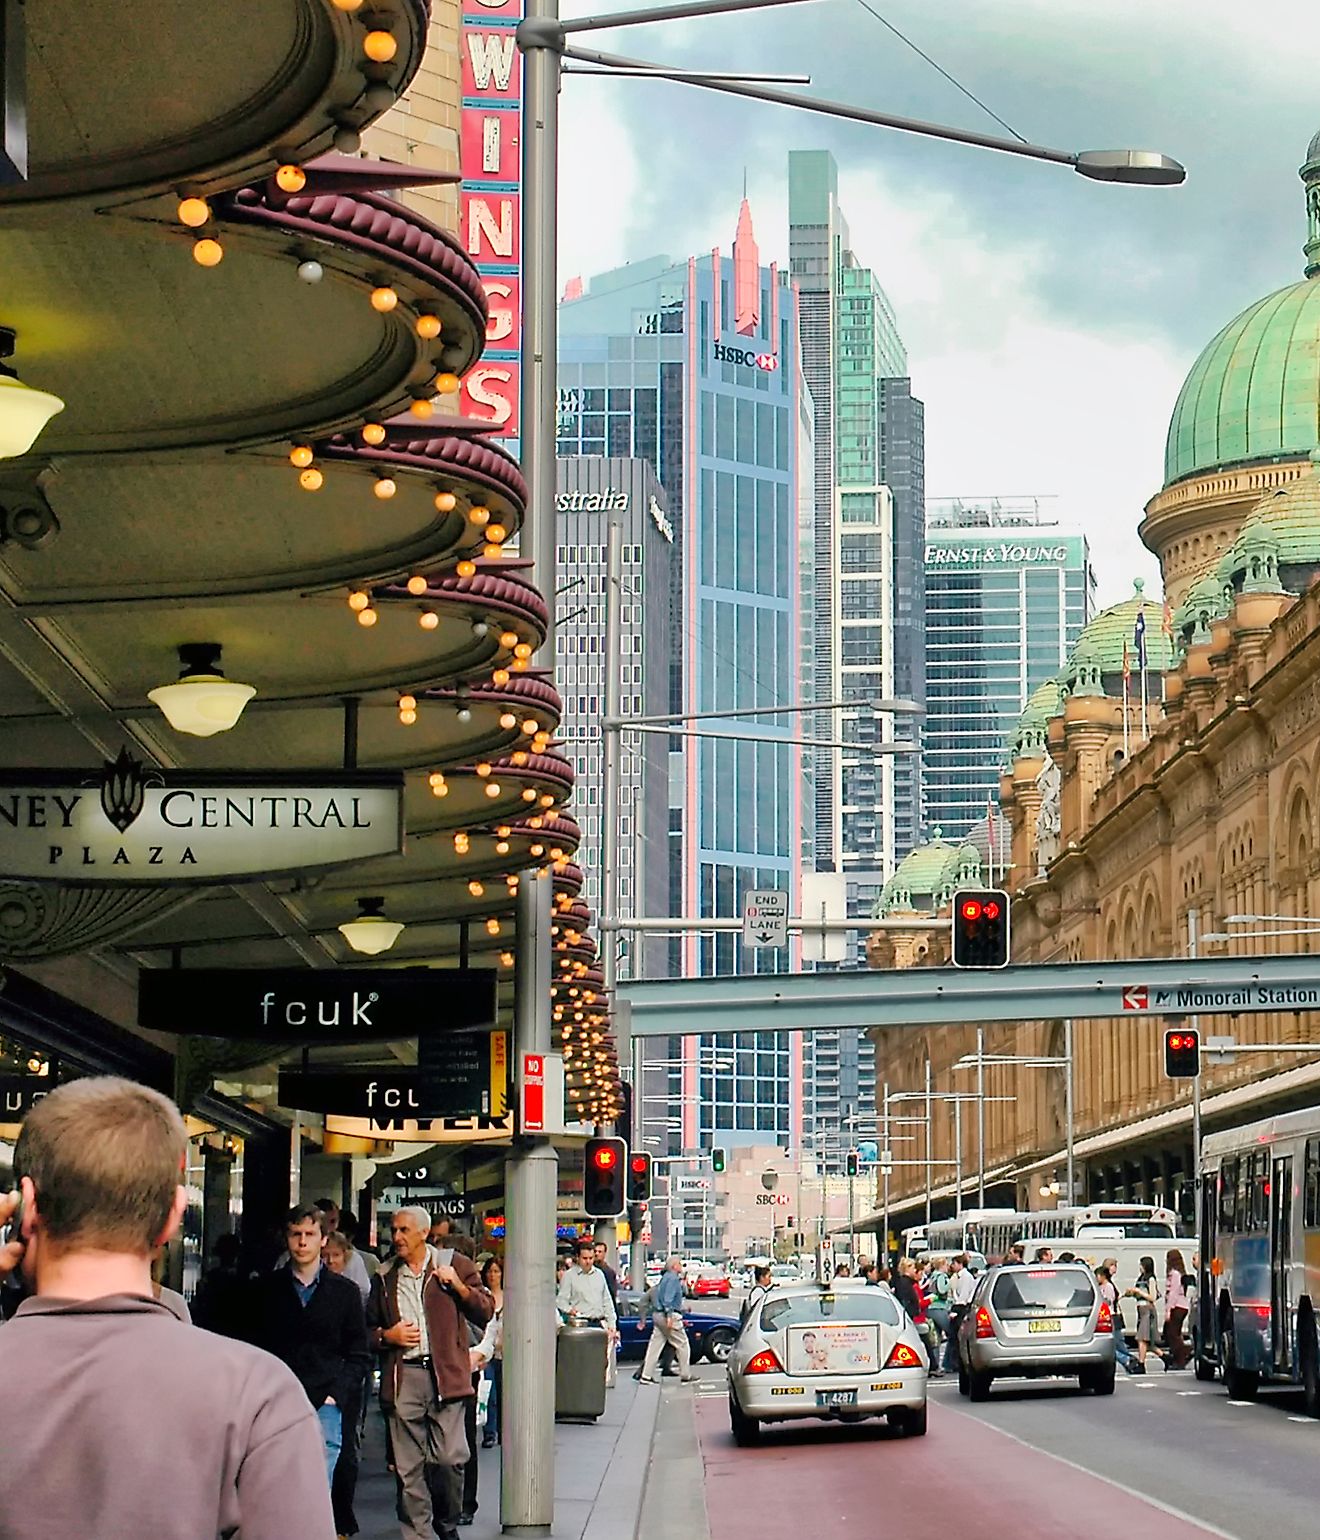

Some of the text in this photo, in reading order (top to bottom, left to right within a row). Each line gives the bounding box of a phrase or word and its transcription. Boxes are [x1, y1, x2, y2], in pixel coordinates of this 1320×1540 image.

[466, 0, 517, 424] WINGS
[714, 344, 756, 368] HSBC
[924, 543, 1068, 563] ERNST & YOUNG
[160, 790, 371, 828] CENTRAL
[49, 847, 198, 864] PLAZA
[755, 896, 778, 905] END
[750, 920, 781, 930] LANE
[1177, 988, 1251, 1007] Monorail
[1257, 986, 1318, 1004] Station
[494, 1035, 504, 1066] SAFE
[527, 1059, 540, 1073] NO
[821, 1391, 854, 1404] T 4287
